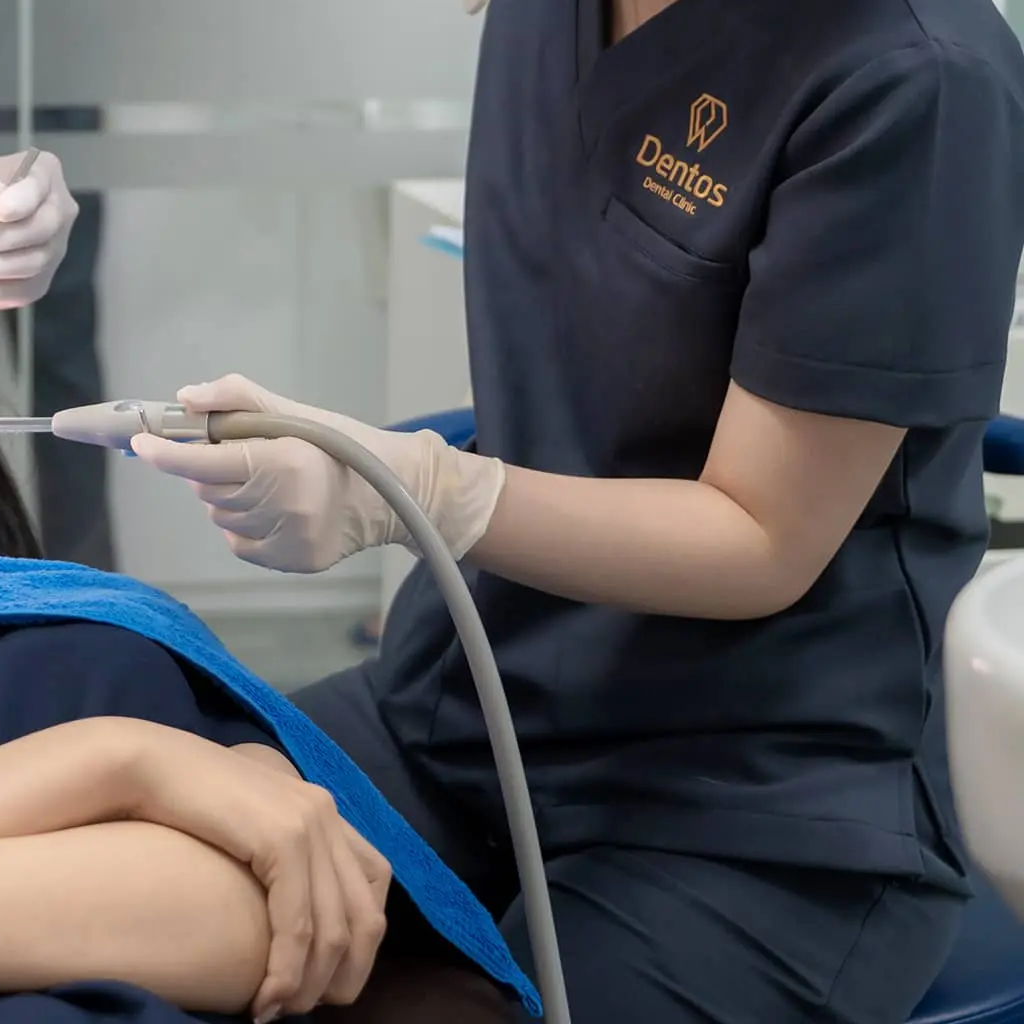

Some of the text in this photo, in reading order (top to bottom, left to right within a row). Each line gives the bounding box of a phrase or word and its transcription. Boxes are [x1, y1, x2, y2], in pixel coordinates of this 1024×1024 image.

[636, 134, 728, 207] Dentos
[643, 176, 697, 215] Dental Clinic
